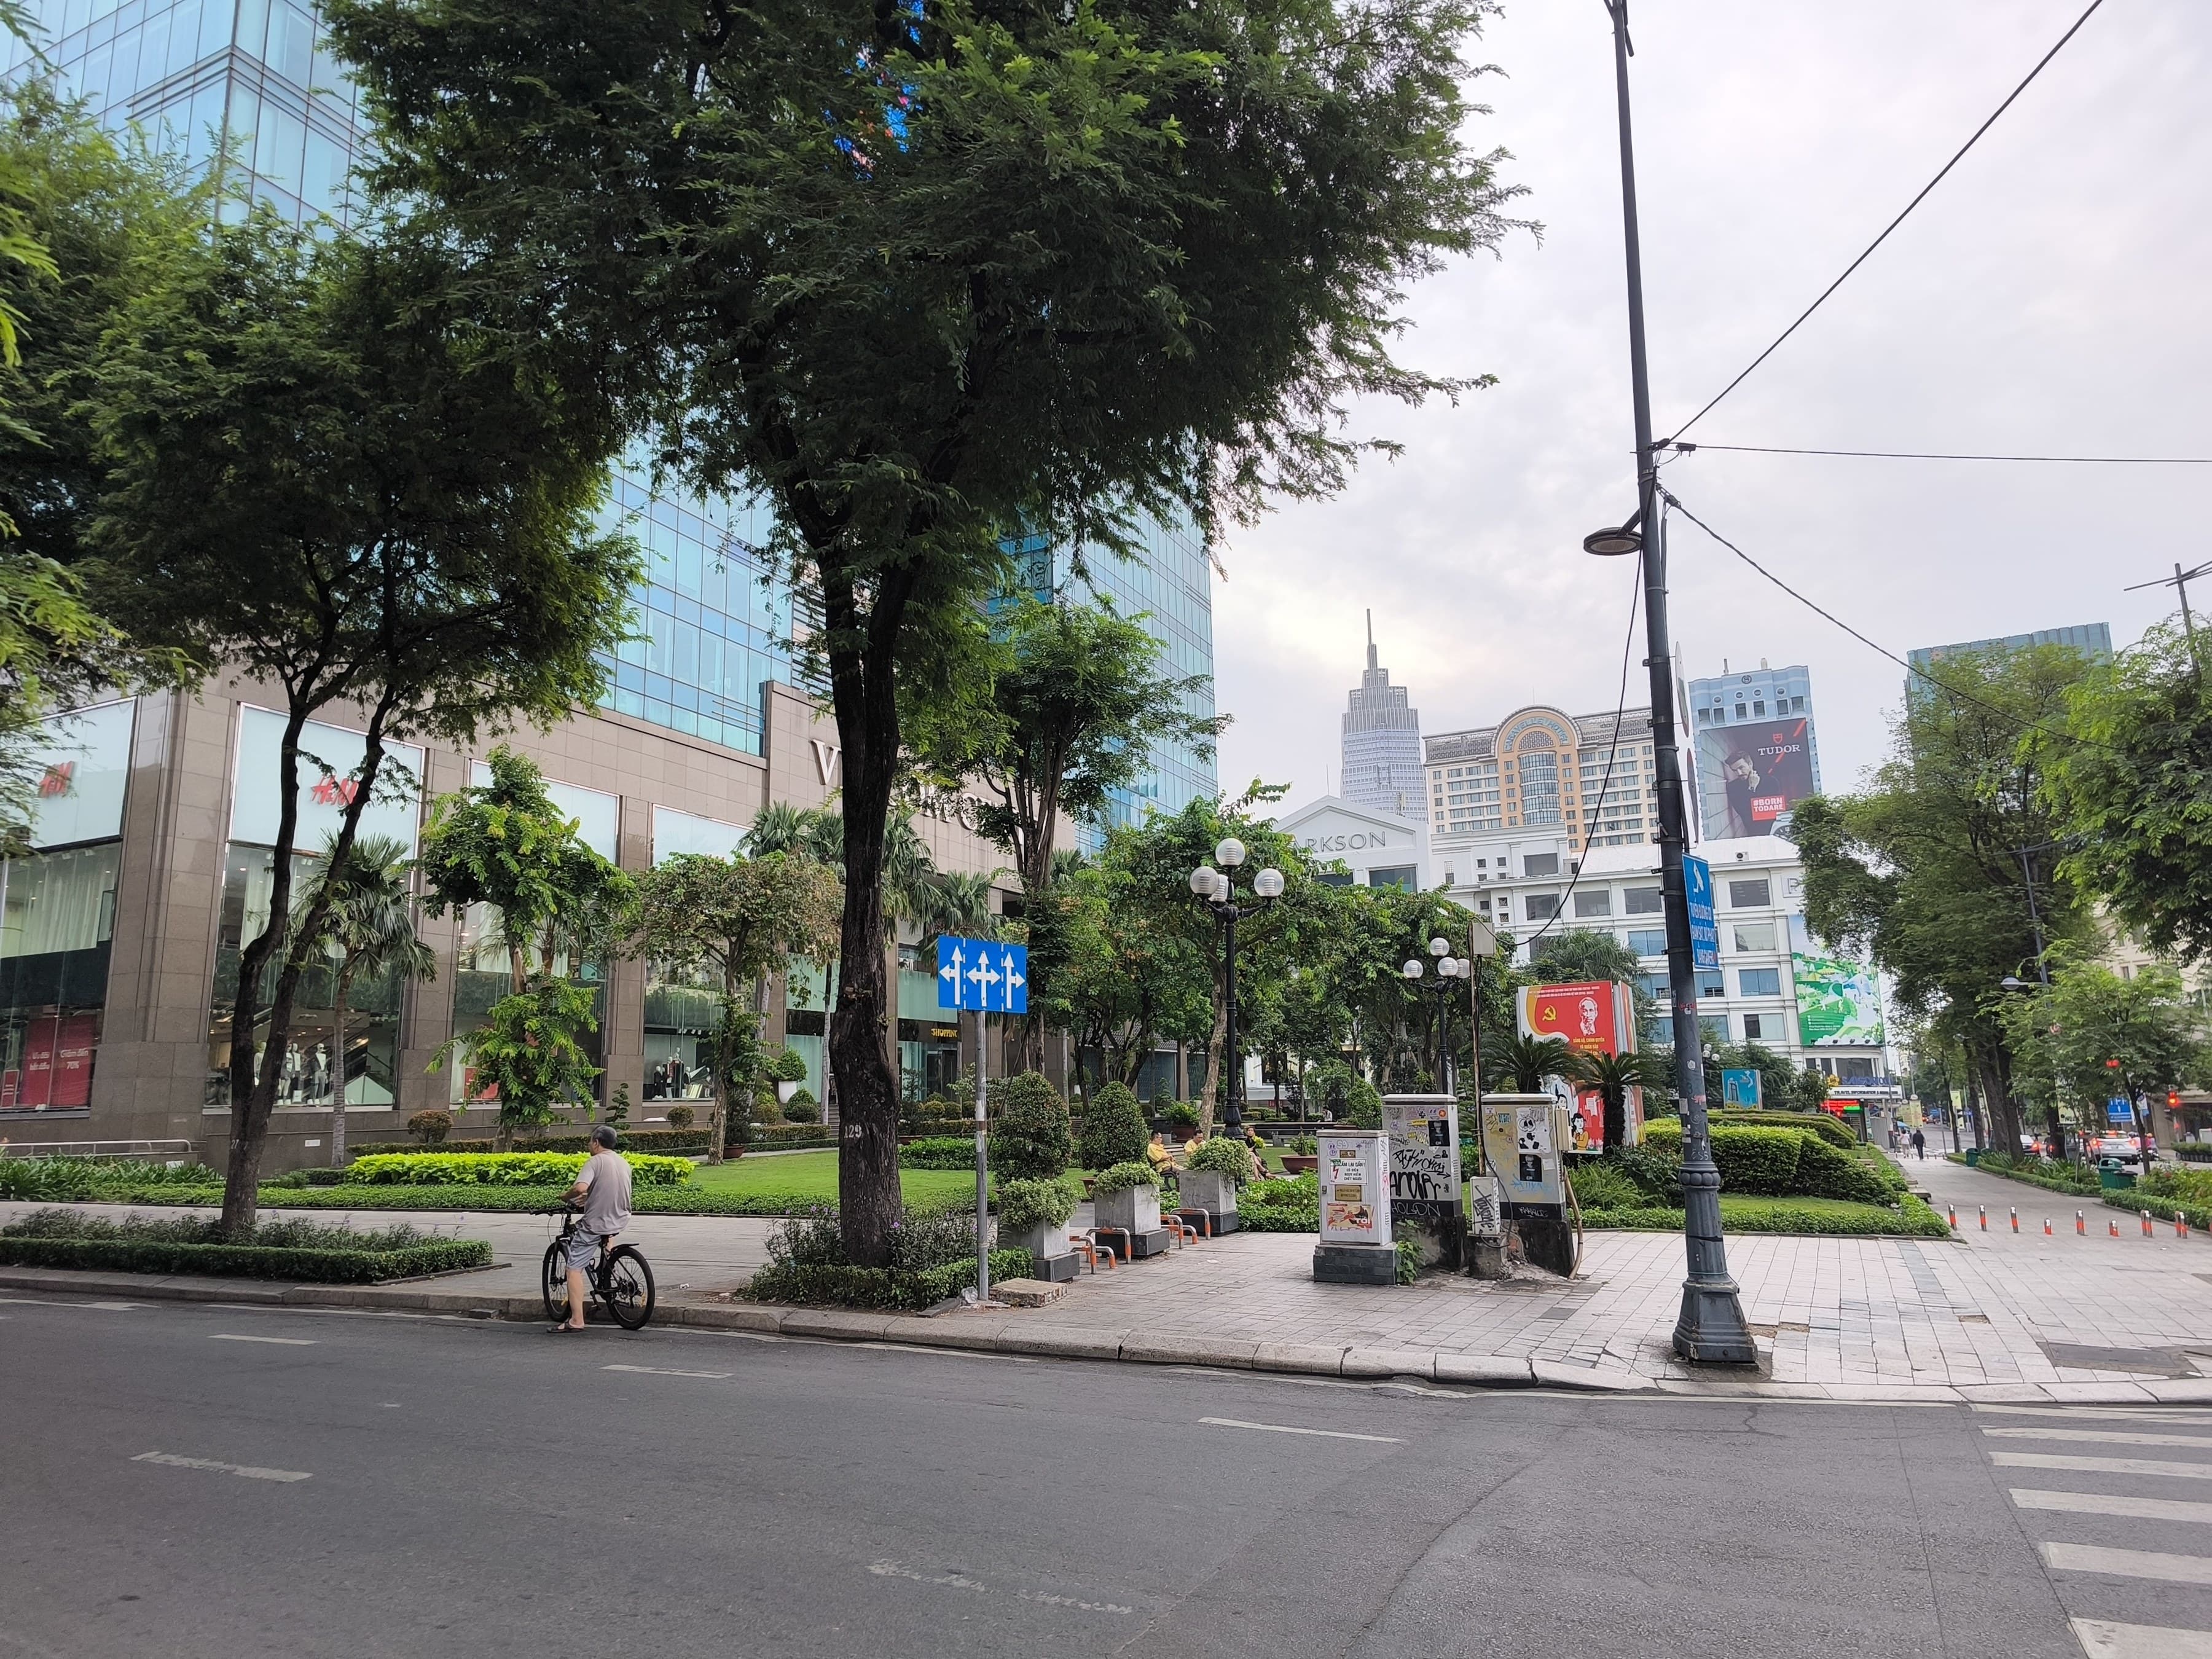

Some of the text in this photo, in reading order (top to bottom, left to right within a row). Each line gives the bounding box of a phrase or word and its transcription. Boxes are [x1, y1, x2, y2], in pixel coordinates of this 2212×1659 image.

[1758, 744, 1801, 755] TUDOR
[1753, 798, 1783, 806] #BORN
[1292, 831, 1386, 853] ARKSON
[844, 1124, 862, 1138] 129
